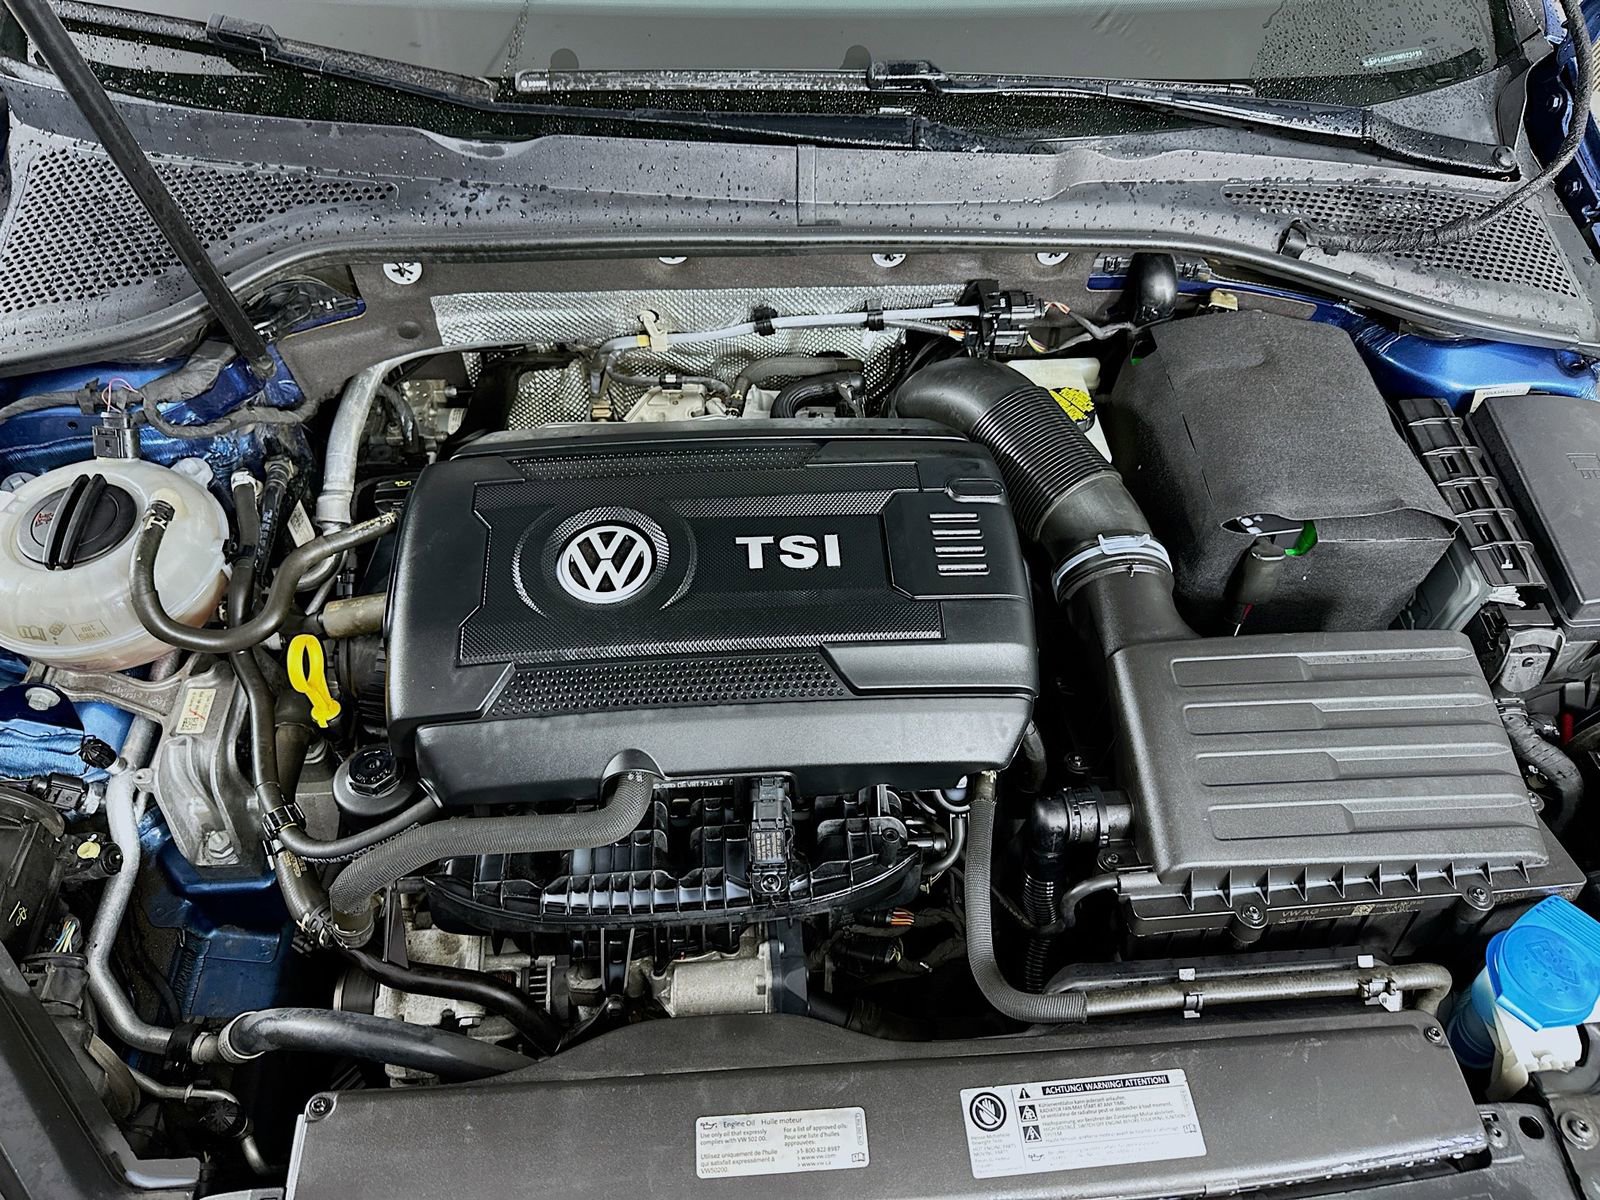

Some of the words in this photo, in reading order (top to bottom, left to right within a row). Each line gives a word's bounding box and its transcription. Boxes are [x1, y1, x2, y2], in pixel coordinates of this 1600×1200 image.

[735, 534, 841, 570] TSI
[556, 525, 652, 604] VW
[1045, 1083, 1084, 1095] ACHTUNG!
[1085, 1080, 1123, 1091] WARNING!
[1125, 1075, 1167, 1087] ATTENTION!
[723, 1121, 745, 1129] Engine
[761, 1118, 778, 1126] Huile
[813, 1124, 836, 1132] approved
[711, 1131, 722, 1139] only
[721, 1151, 753, 1159] uniquement
